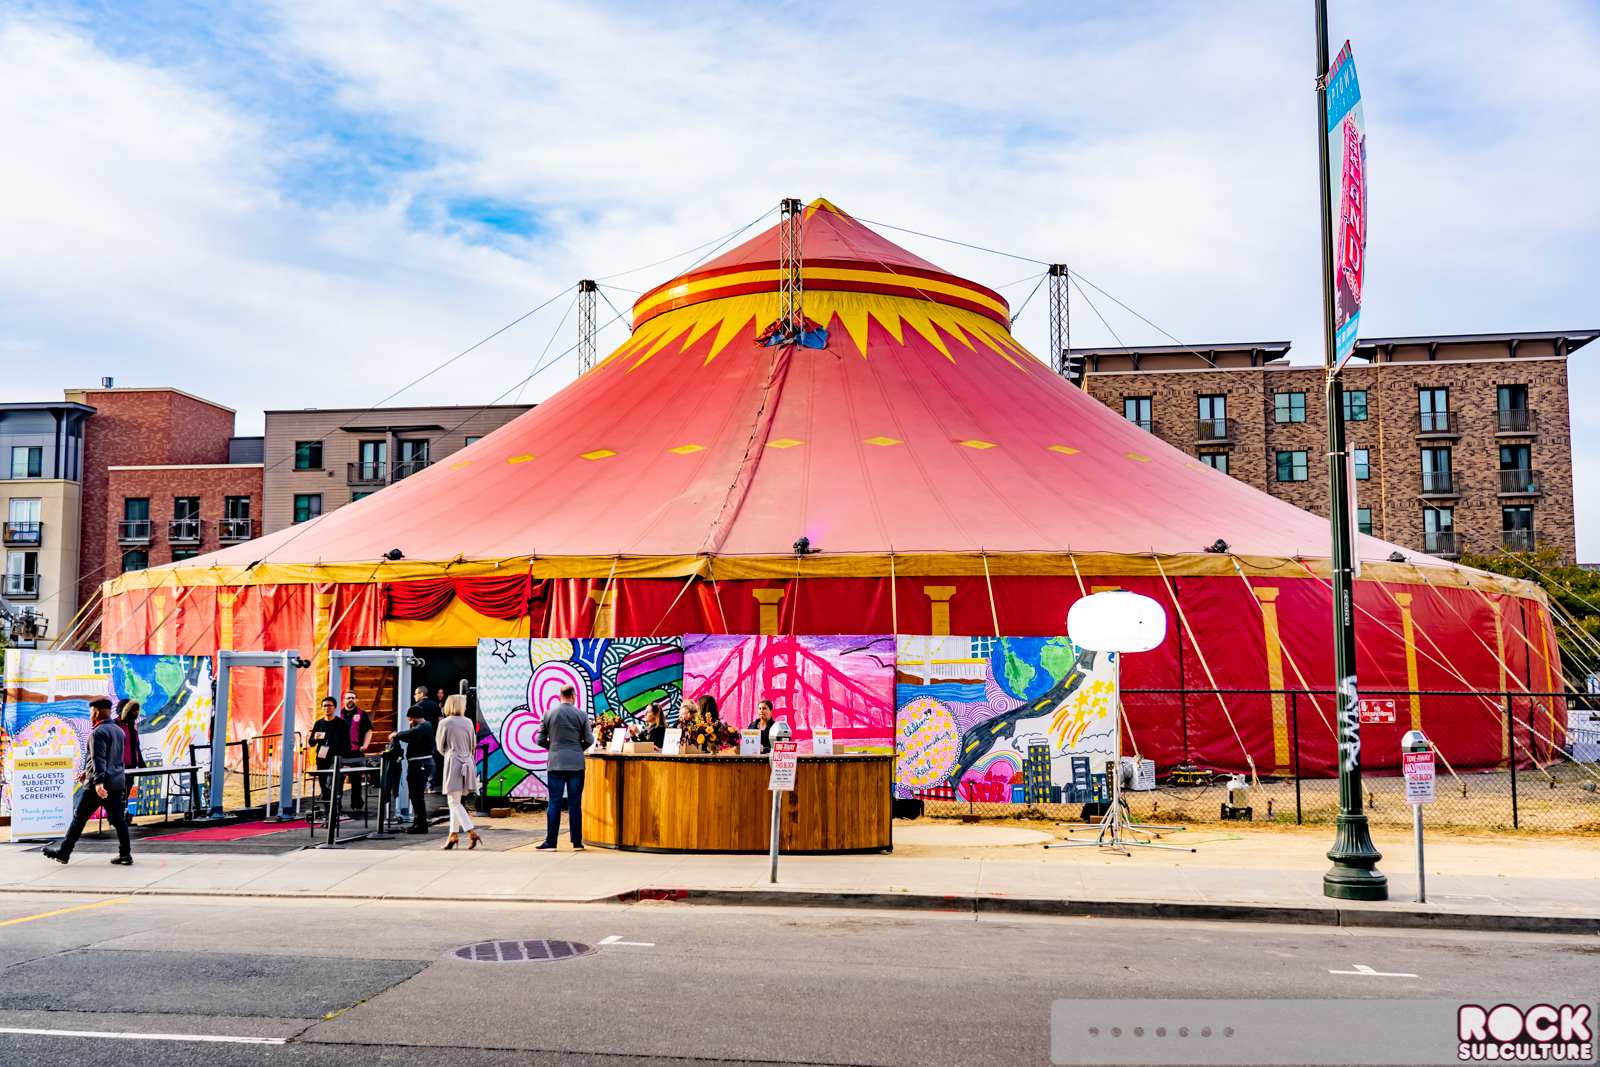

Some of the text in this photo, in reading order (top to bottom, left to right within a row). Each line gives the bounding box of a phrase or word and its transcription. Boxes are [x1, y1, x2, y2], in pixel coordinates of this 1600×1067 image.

[1328, 62, 1355, 110] UPTOWN
[775, 743, 795, 751] TOW-AWAY
[774, 751, 782, 760] NO
[1406, 754, 1431, 762] TOW-AWAY
[1405, 763, 1415, 773] NO
[1409, 773, 1433, 781] THIS BLOCK
[36, 814, 64, 822] patience.
